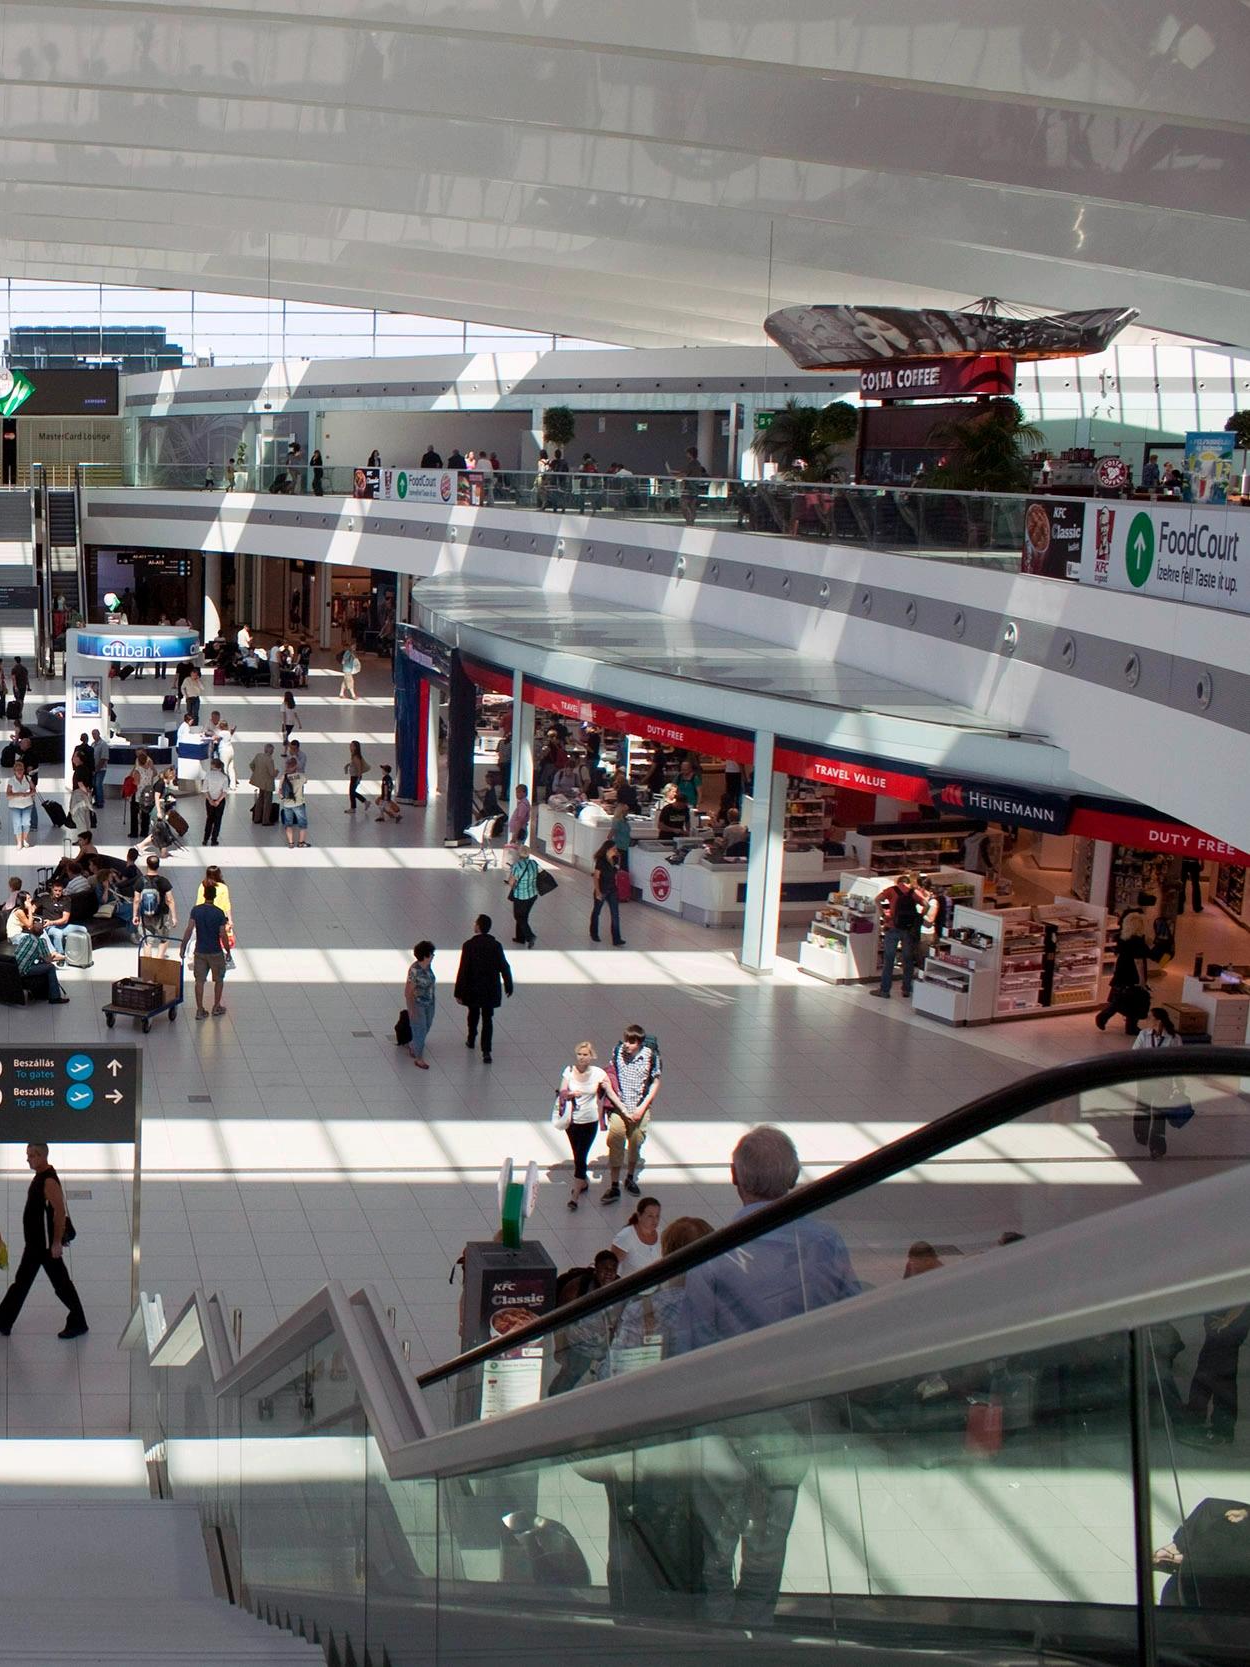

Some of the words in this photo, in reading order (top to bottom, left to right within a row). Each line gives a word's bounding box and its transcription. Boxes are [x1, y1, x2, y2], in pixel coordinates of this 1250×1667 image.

[861, 370, 892, 390] COSTA
[896, 367, 940, 388] COFFEE
[38, 432, 82, 440] MasterCard
[83, 432, 111, 442] Lounge
[1103, 459, 1123, 469] COSTA
[1101, 475, 1124, 487] COFFEE
[1053, 507, 1067, 518] KFC
[1051, 523, 1081, 540] Classic
[1158, 521, 1239, 562] FoodCourt
[1094, 561, 1109, 574] KFC
[1195, 567, 1216, 589] Taste
[1218, 571, 1224, 590] it
[1224, 574, 1238, 593] up.
[102, 641, 161, 657] citibank
[561, 701, 579, 713] TRAVEL
[647, 724, 666, 737] DUTY
[667, 729, 684, 741] FREE
[814, 764, 850, 781] TRAVEL
[853, 772, 887, 788] VALUE
[969, 791, 1055, 822] HEINEMANN
[1149, 830, 1191, 847] DUTY
[1197, 838, 1236, 855] FREE
[13, 1059, 55, 1068] Beszállás
[15, 1070, 26, 1078] To
[29, 1071, 55, 1080] gates
[13, 1087, 55, 1096] Beszállás
[15, 1099, 26, 1107] To
[29, 1099, 55, 1109] gates
[493, 1281, 517, 1291] KFC
[491, 1293, 544, 1306] Classic
